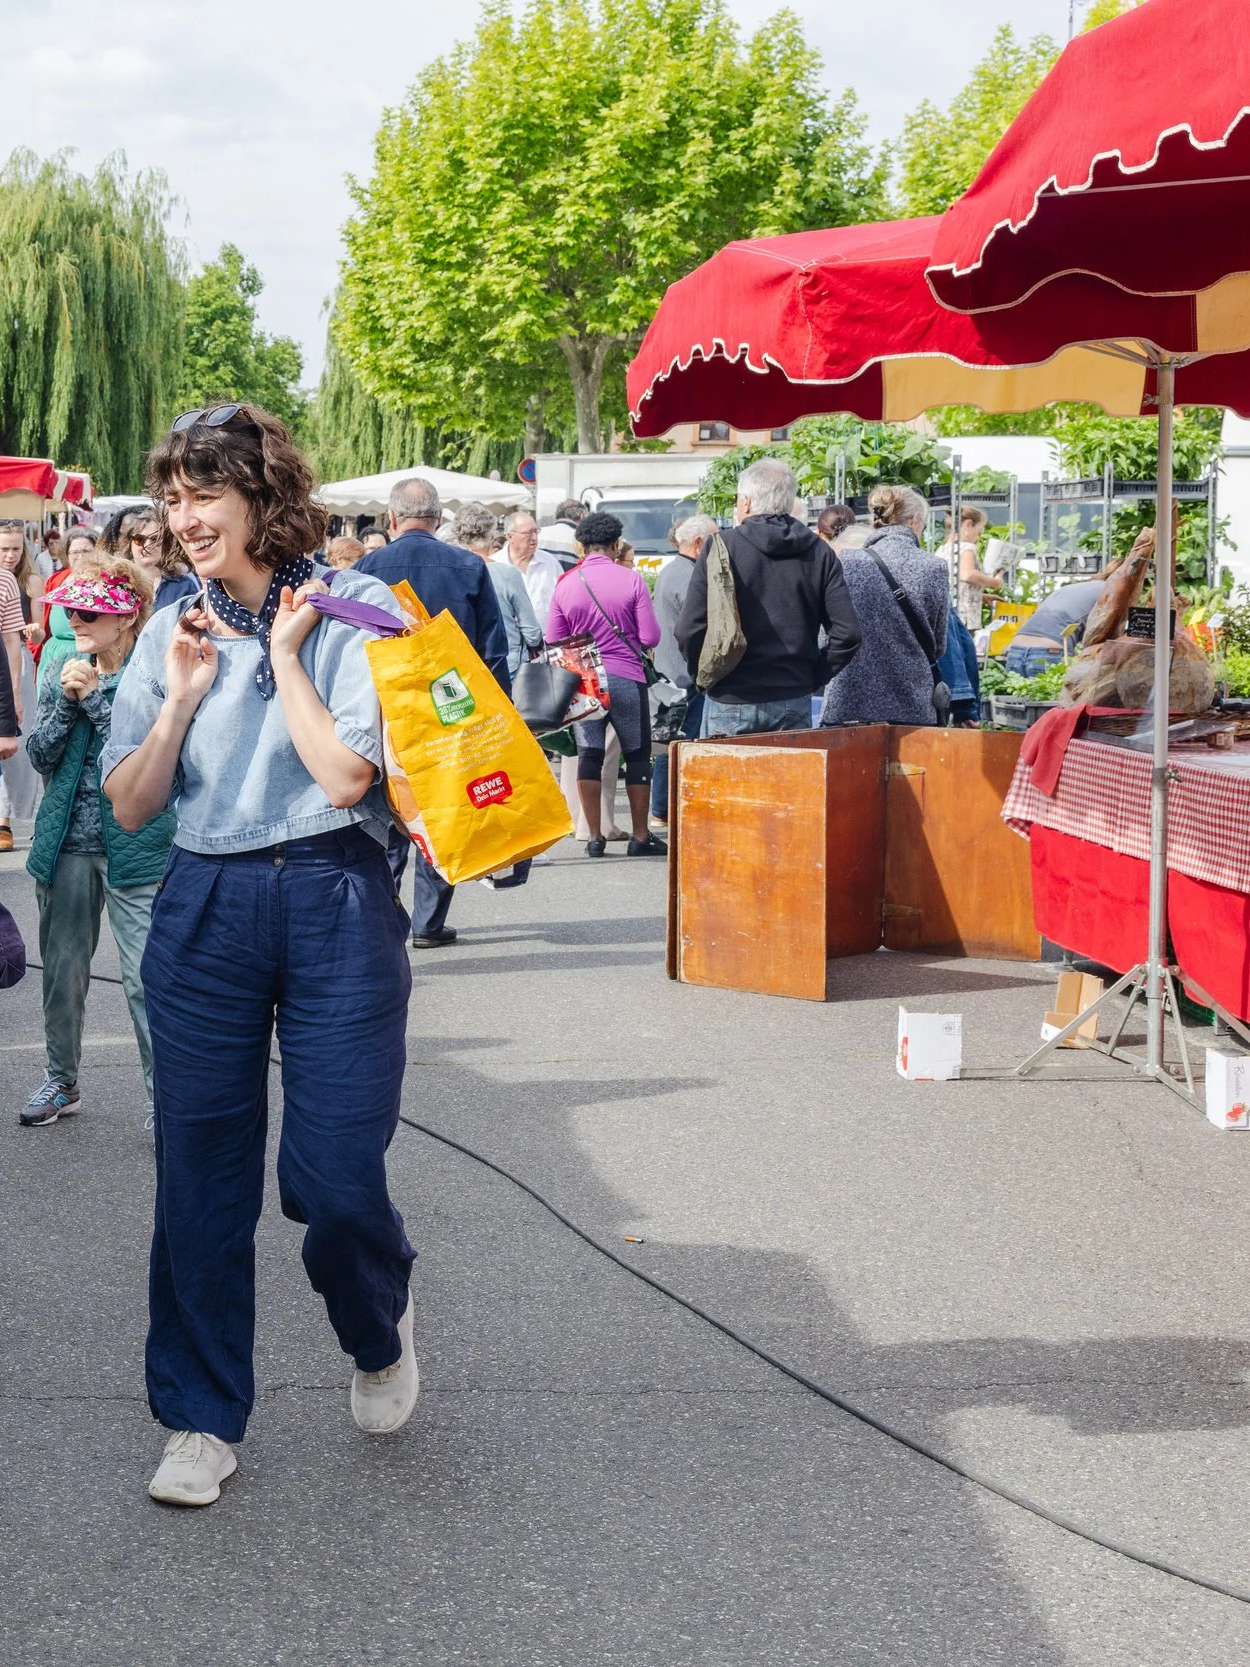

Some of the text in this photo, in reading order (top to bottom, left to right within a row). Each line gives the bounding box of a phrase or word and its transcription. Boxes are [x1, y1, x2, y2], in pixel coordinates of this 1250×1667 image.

[438, 705, 452, 715] 36%
[442, 711, 467, 723] PLASTIK
[473, 776, 503, 795] REWE
[476, 786, 506, 802] Dein Markt
